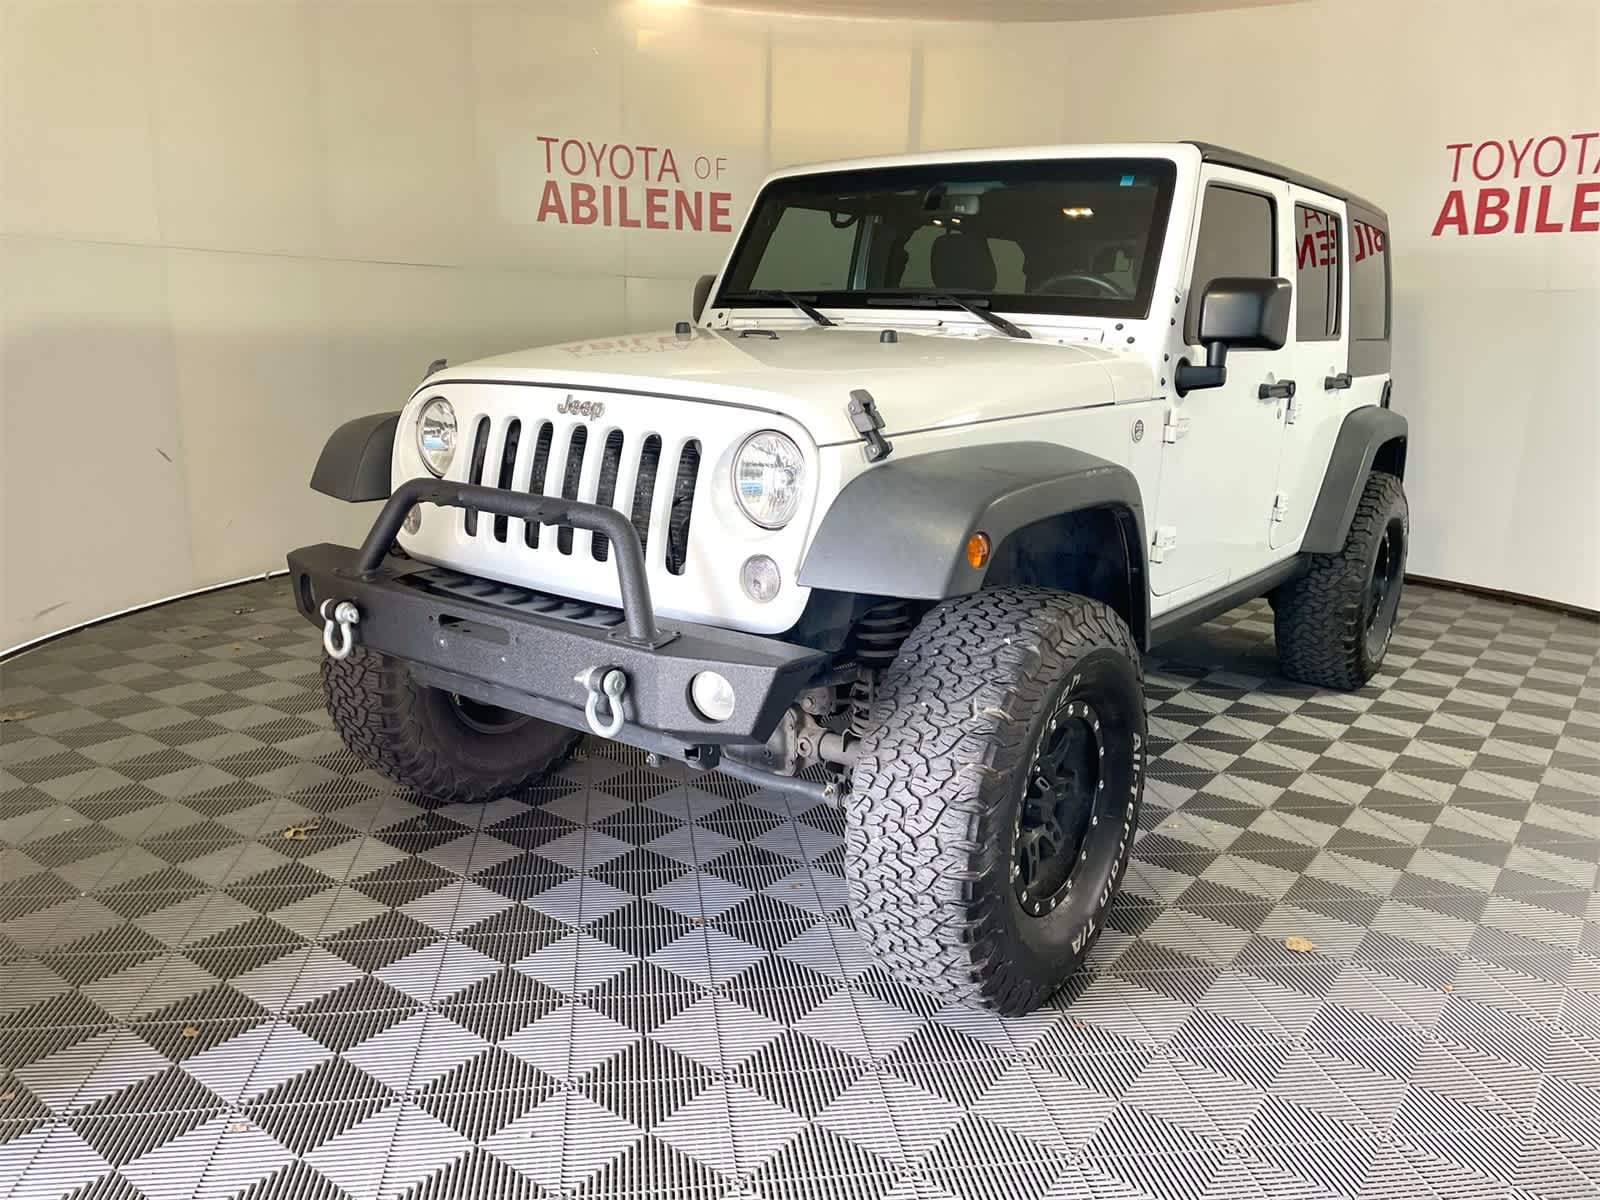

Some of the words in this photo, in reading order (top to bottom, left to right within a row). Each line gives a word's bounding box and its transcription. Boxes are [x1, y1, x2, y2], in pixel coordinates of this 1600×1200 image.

[537, 136, 680, 183] TOYOTA
[694, 156, 727, 180] OF
[536, 180, 732, 232] ABILENE
[1431, 183, 1600, 236] ABILE
[557, 394, 605, 421] Jeep
